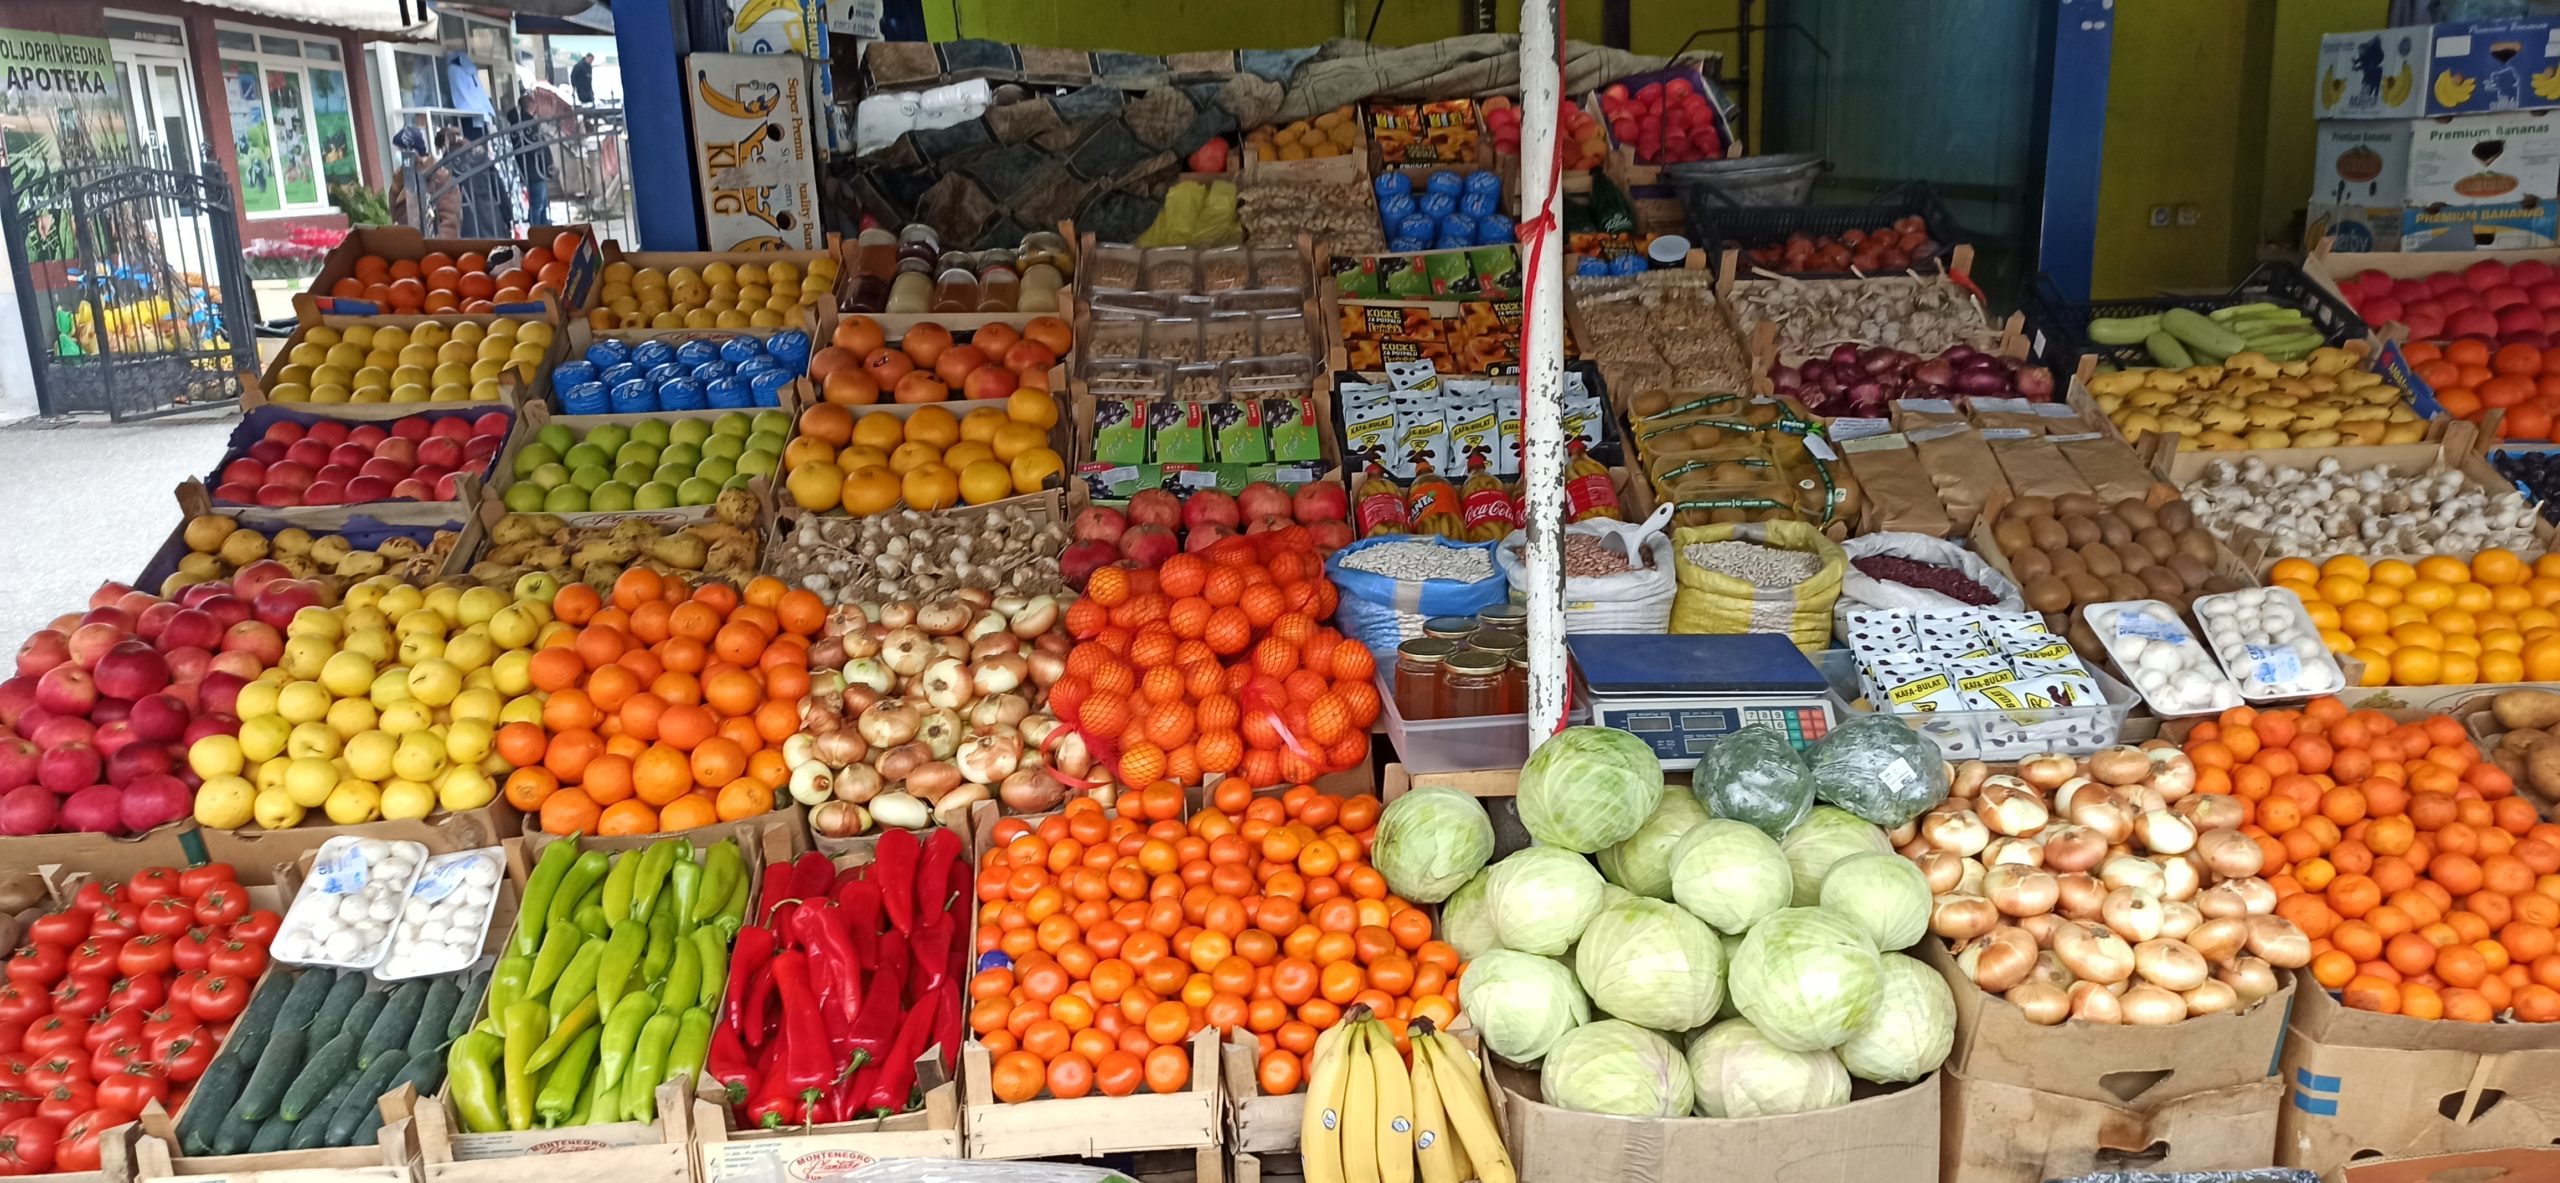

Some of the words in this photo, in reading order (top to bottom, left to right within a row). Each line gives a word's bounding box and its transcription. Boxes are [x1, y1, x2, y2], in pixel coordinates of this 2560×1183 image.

[7, 66, 107, 95] APOTEKA
[787, 77, 800, 115] Super
[792, 117, 805, 161] Premiu
[2430, 127, 2491, 141] Premium
[2495, 123, 2550, 136] Bananas
[706, 143, 742, 216] KIG
[799, 182, 810, 217] uality
[2415, 210, 2478, 224] PREMIUM
[2480, 207, 2545, 221] BANANAS
[2337, 228, 2369, 249] erby
[1366, 308, 1401, 319] KOCKE
[1493, 302, 1522, 312] KOCK
[1381, 342, 1417, 352] KOCKE
[1350, 419, 1389, 435] KAFA-BULAT
[1403, 424, 1439, 438] A-BULAT
[1453, 418, 1492, 436] KAFA-BULAT
[1464, 499, 1515, 523] Coca-Cola
[2021, 645, 2065, 660] AFA-BULAT
[1894, 679, 1943, 700] KAFA-BULAT
[1963, 673, 2010, 691] KAFA-BULAT
[1748, 711, 1755, 719] 7
[1761, 711, 1768, 719] 8
[1774, 711, 1782, 719] 9
[1777, 721, 1784, 729] 6
[531, 1138, 607, 1152] MONTENEGRO
[796, 1150, 871, 1166] MONTENEGRO
